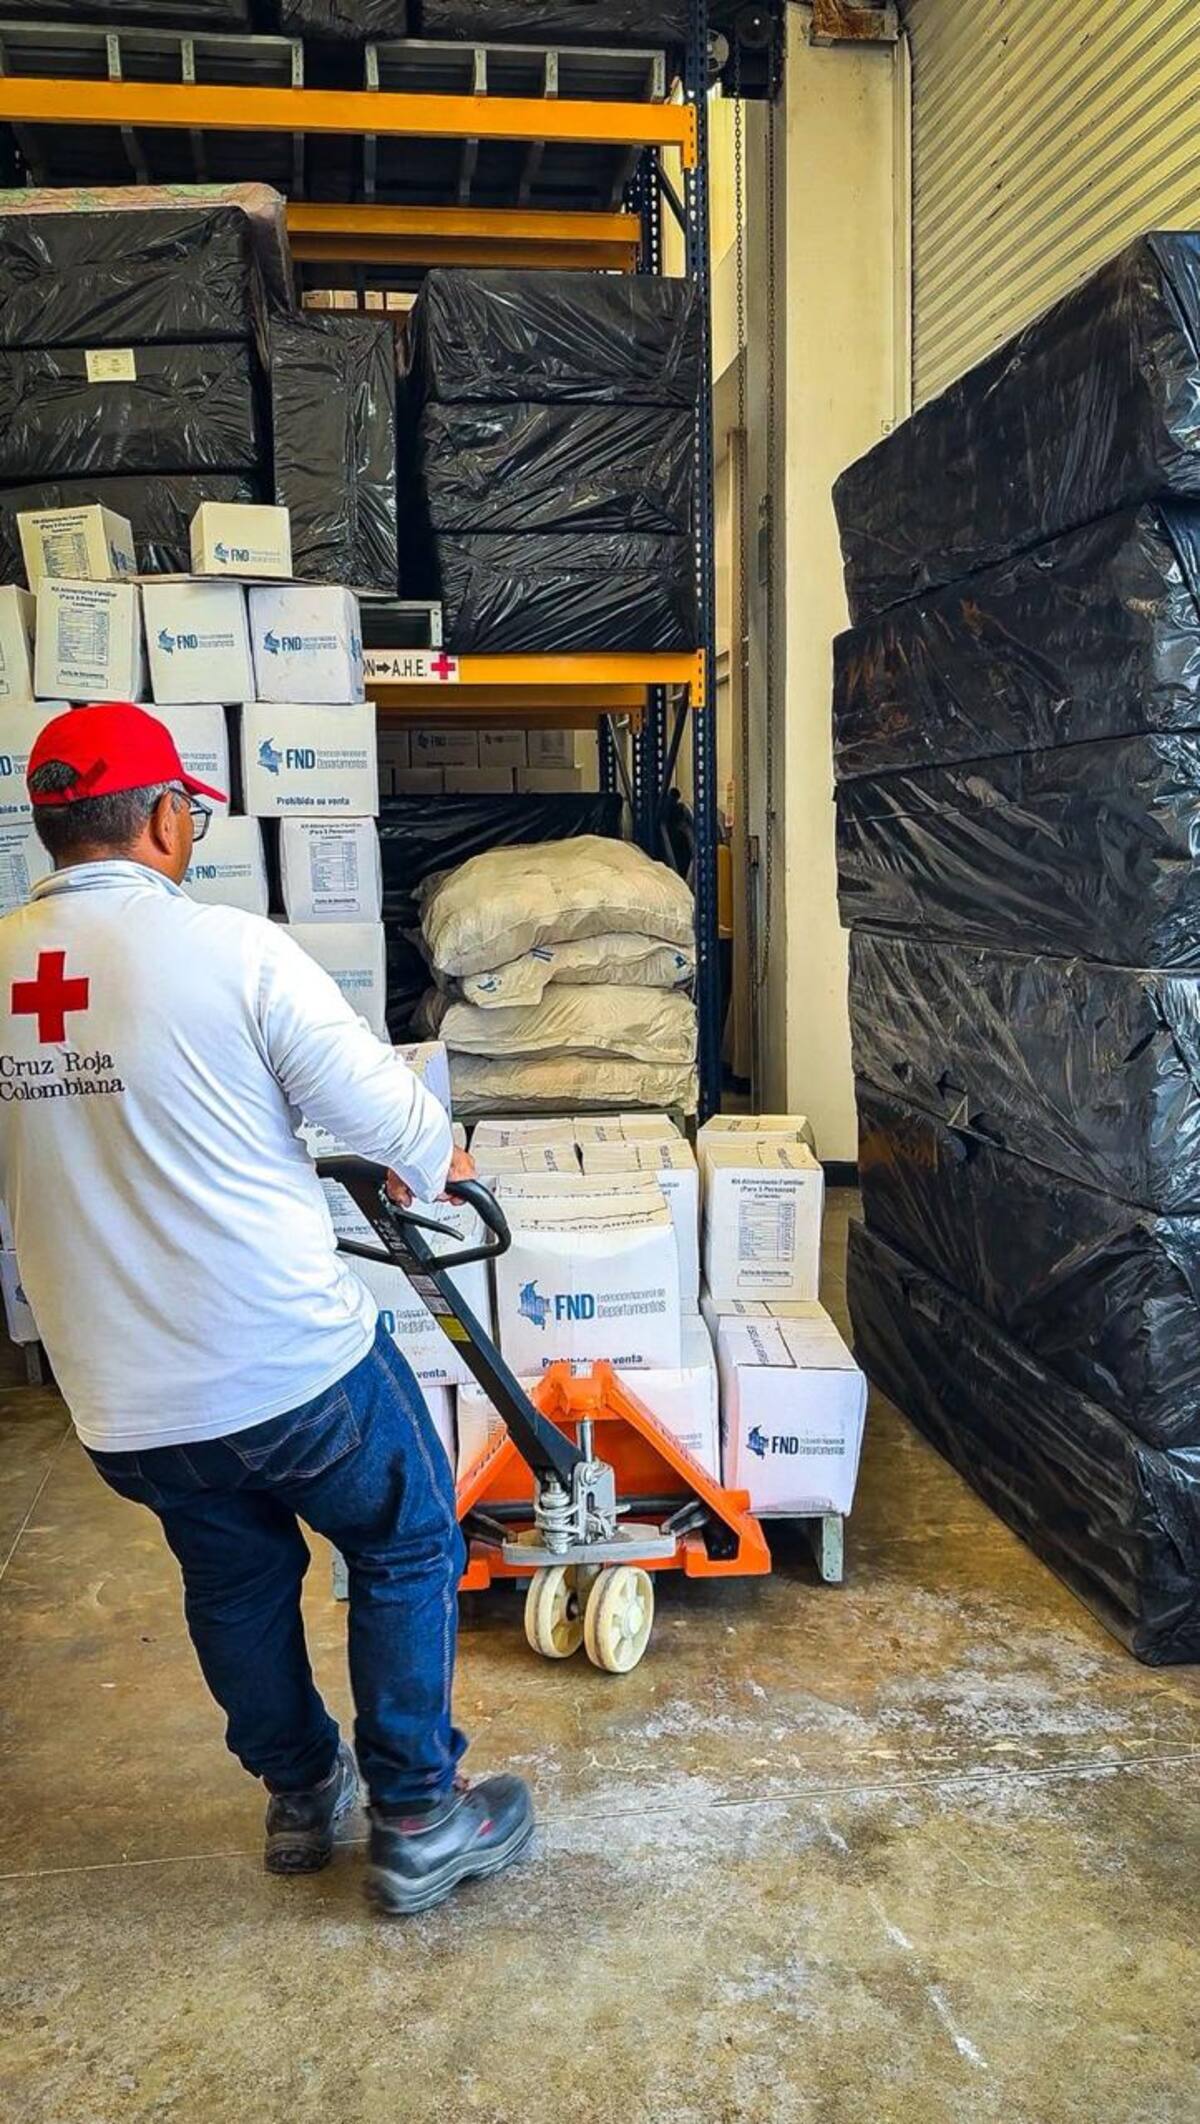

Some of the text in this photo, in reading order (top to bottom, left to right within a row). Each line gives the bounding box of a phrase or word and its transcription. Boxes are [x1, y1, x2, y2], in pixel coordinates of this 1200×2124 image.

[231, 549, 249, 561] FND
[177, 634, 198, 649] FND
[282, 637, 302, 650] FND
[391, 659, 428, 676] A.H.E.
[286, 749, 315, 769] FND
[277, 797, 314, 805] Prohibida
[328, 797, 349, 805] venta
[196, 865, 216, 879] FND
[0, 1051, 114, 1077] Cruz Roja
[0, 1077, 125, 1101] Colombiana
[555, 1293, 594, 1320] FND
[613, 1354, 643, 1364] venta
[417, 1369, 447, 1379] venta
[772, 1436, 798, 1454] FND
